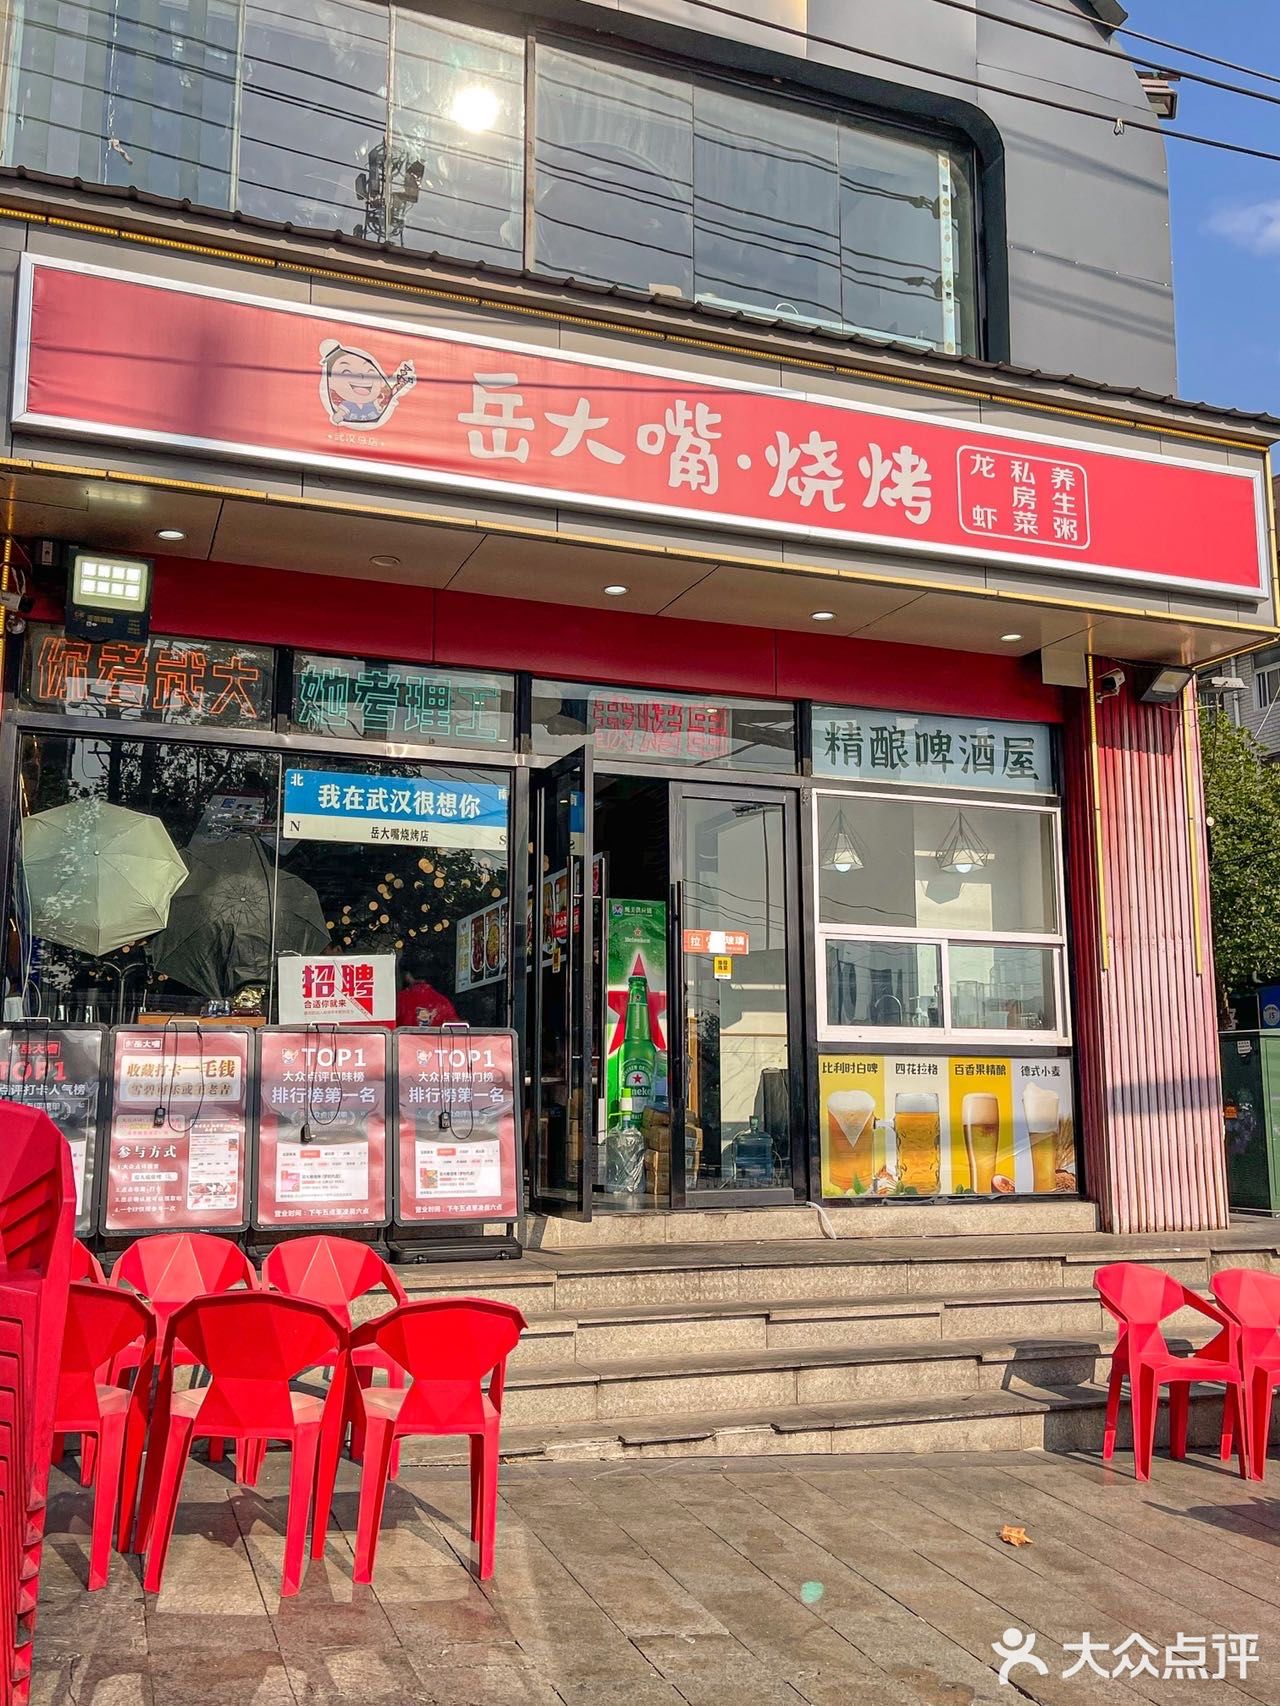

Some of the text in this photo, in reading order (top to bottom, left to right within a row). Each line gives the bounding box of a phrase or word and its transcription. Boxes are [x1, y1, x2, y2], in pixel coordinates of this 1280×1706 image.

[970, 453, 997, 530] 龙虾
[1010, 460, 1038, 535] 私房菜
[1050, 467, 1078, 541] 养生粥
[299, 665, 497, 739] 她考理工
[824, 721, 1039, 780] 精酿啤酒屋
[291, 773, 304, 786] 北
[318, 784, 481, 819] 我在武汉很想你
[290, 821, 301, 832] N
[371, 826, 429, 842] 岳大嘴烧烤店
[499, 836, 507, 845] S
[690, 936, 701, 946] 拉
[302, 964, 374, 998] 招聘
[301, 1048, 366, 1067] TOP1
[435, 1049, 496, 1067] TOP1
[127, 1060, 236, 1078] 收藏打卡一毛钱
[283, 1071, 365, 1082] 大众点评口味榜
[822, 1062, 879, 1075] 比利时白啤
[895, 1063, 938, 1075] 四花拉格
[955, 1064, 1007, 1076] 百香果精酿
[1020, 1065, 1061, 1077] 德式小麦
[418, 1072, 494, 1082] 大众点评热门榜
[272, 1087, 375, 1103] 排行榜第一名
[409, 1087, 505, 1103] 排行榜第一名
[118, 1145, 177, 1158] 参与方式
